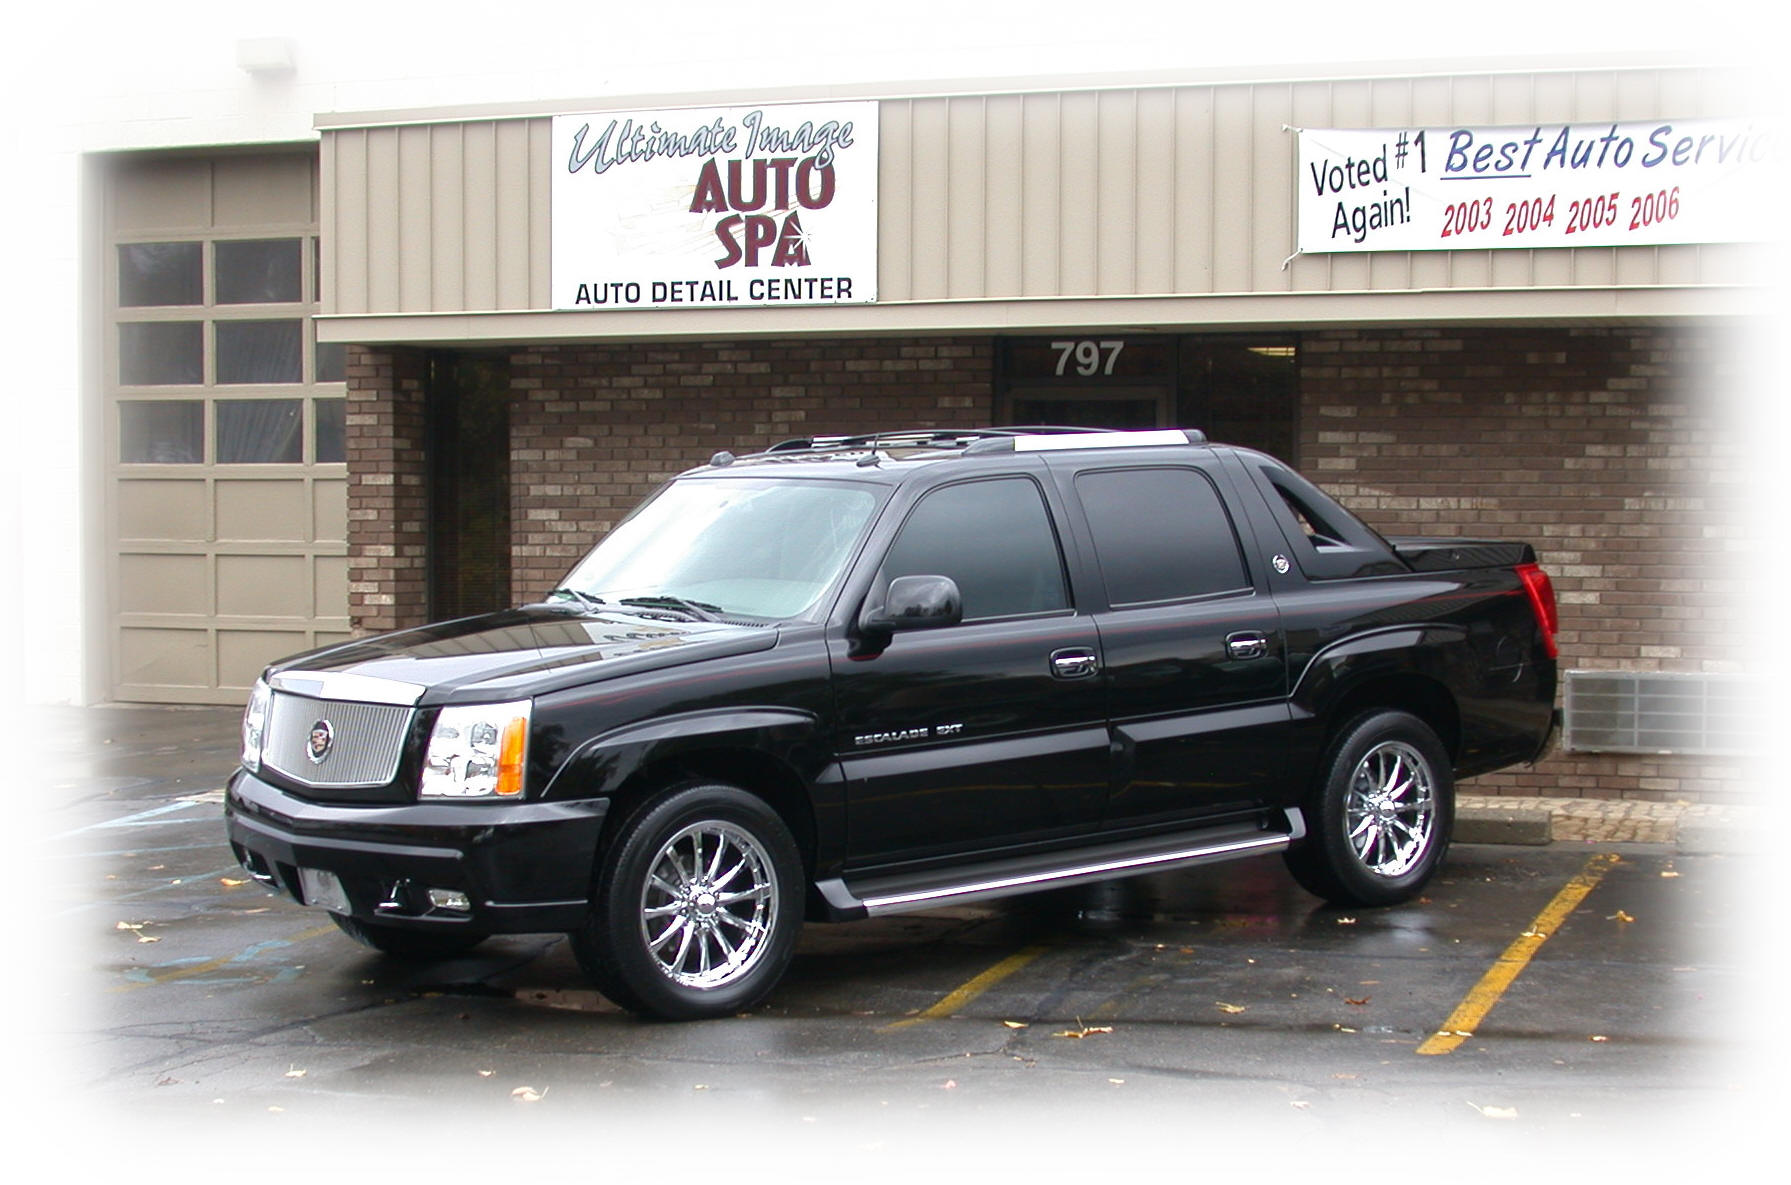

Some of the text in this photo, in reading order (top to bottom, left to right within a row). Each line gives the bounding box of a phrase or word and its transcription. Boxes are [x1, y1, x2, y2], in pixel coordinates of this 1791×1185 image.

[568, 110, 854, 174] Ultimate Image
[1311, 131, 1427, 196] Voted #1
[1445, 123, 1776, 174] Best Auto Servic
[689, 157, 836, 213] AUTO
[1441, 186, 1680, 238] 2003 2004 2005 2006
[714, 210, 811, 270] SPA
[1331, 187, 1412, 243] Again!
[576, 278, 852, 304] AUTO DETAIL CENTER
[1051, 342, 1125, 376] 797
[855, 724, 963, 745] ESCALADE EXT
